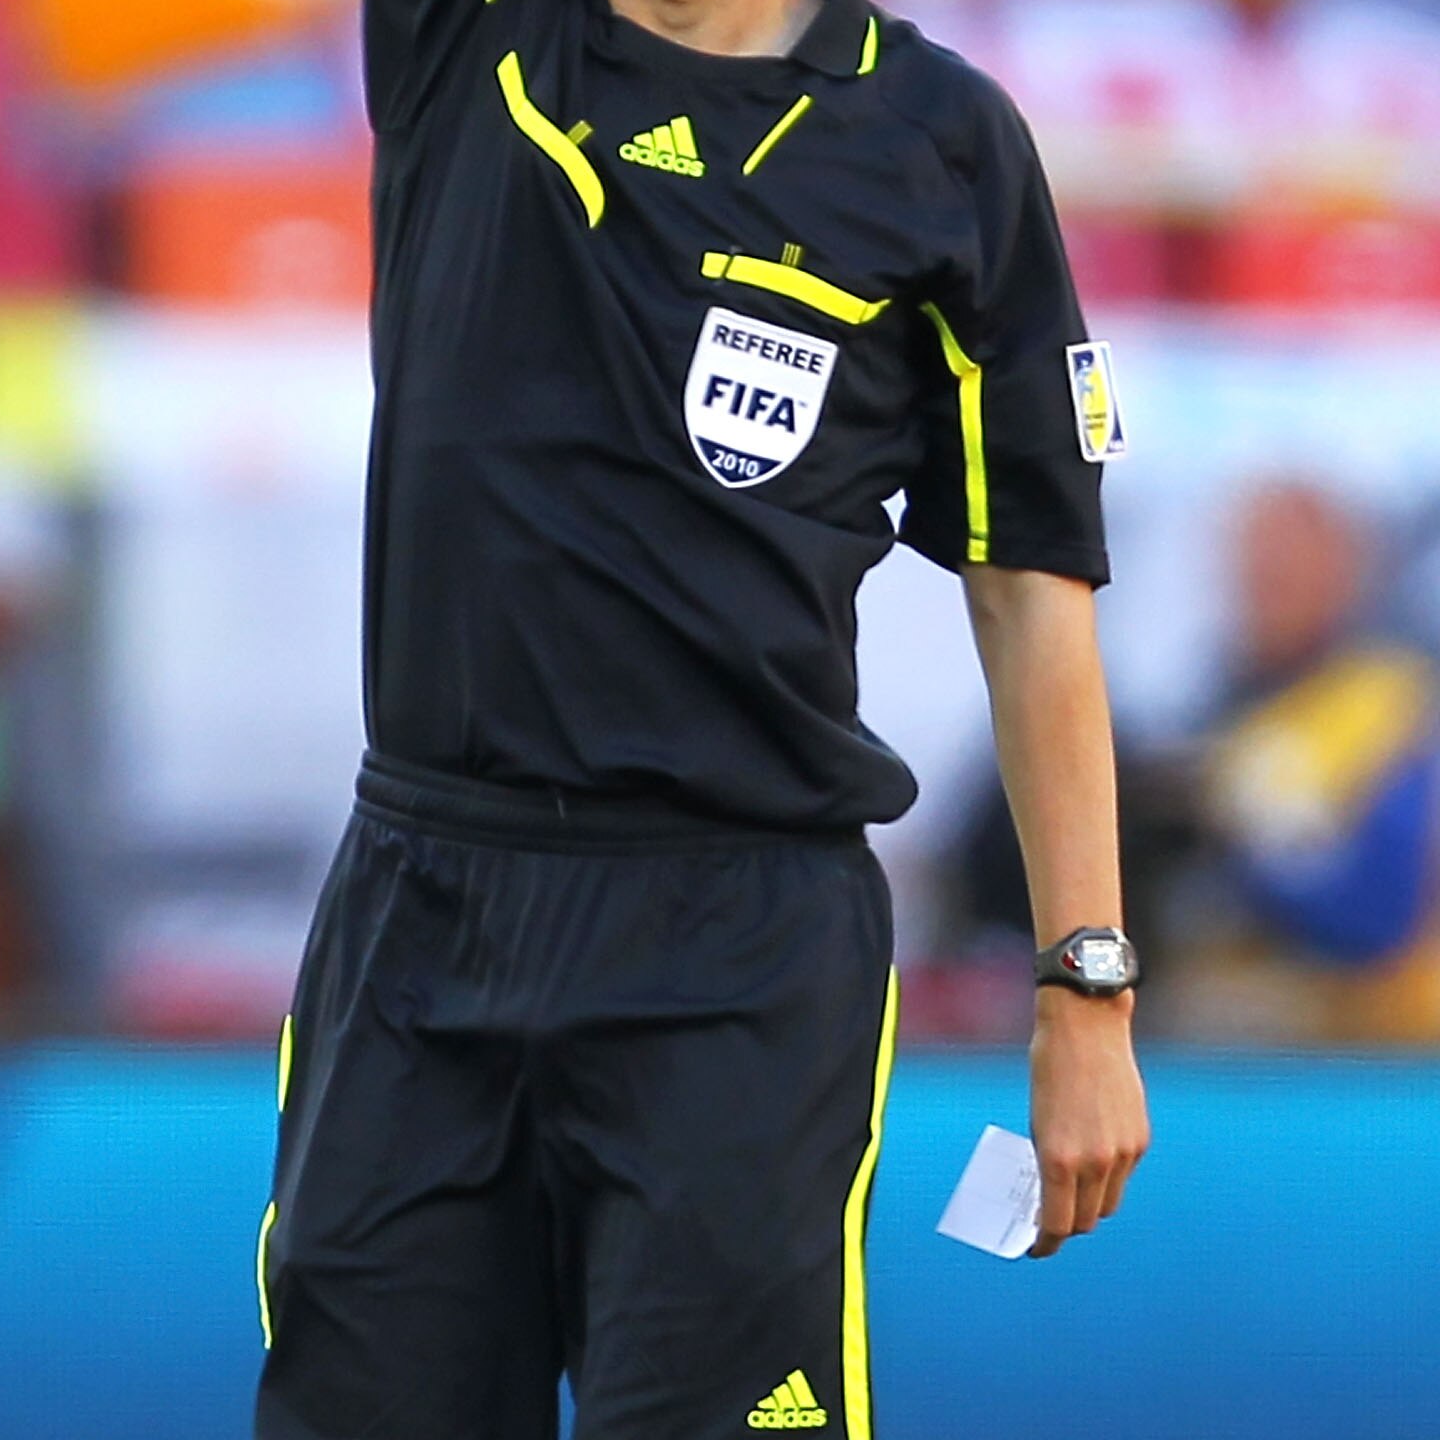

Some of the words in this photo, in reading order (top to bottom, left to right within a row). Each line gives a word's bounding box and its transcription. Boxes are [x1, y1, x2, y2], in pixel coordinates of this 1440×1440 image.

[619, 143, 705, 177] adidas
[712, 324, 825, 375] REFEREE
[702, 374, 797, 434] FIFA
[712, 449, 760, 477] 2010
[747, 1408, 827, 1429] adidas
